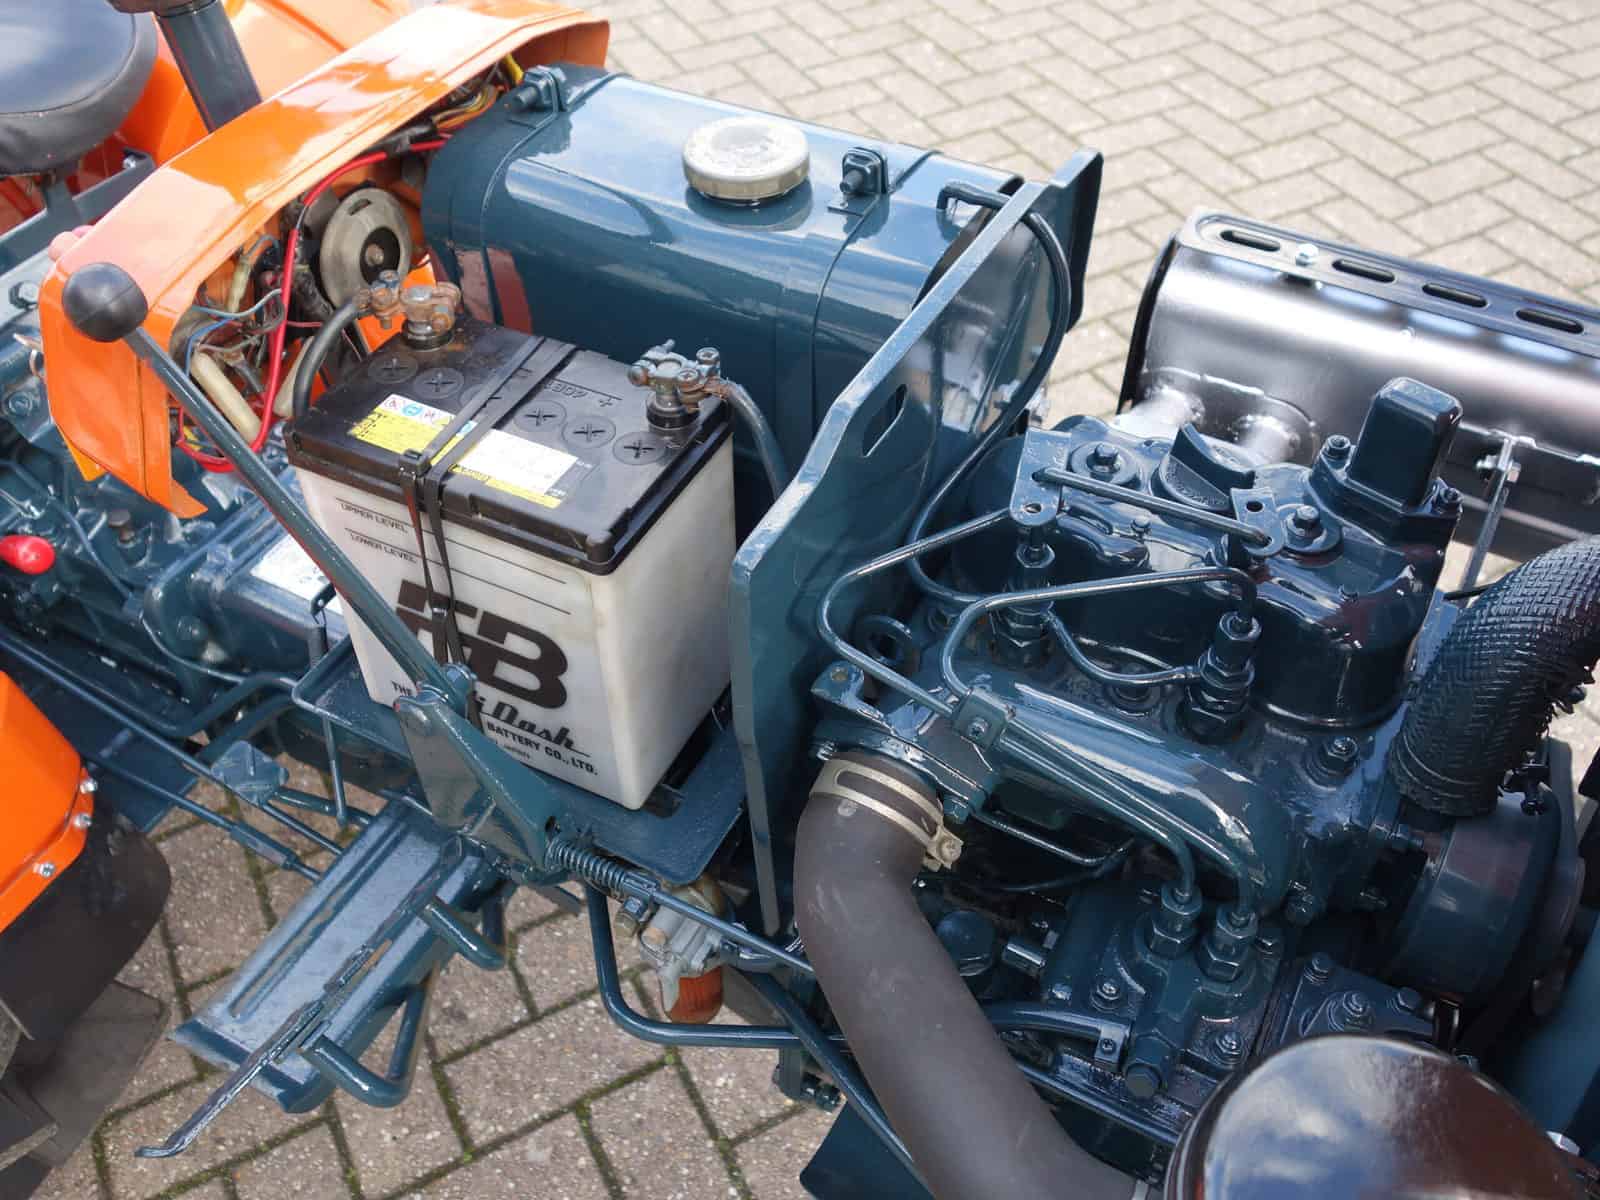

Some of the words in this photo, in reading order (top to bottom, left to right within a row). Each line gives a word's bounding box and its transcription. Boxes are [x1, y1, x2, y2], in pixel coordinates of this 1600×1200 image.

[341, 503, 374, 520] UPPER
[375, 515, 409, 534] LEVEL
[350, 533, 383, 551] LOWER
[384, 544, 418, 564] LEVEL
[486, 721, 541, 751] BATTERY
[571, 755, 599, 776] LTD.
